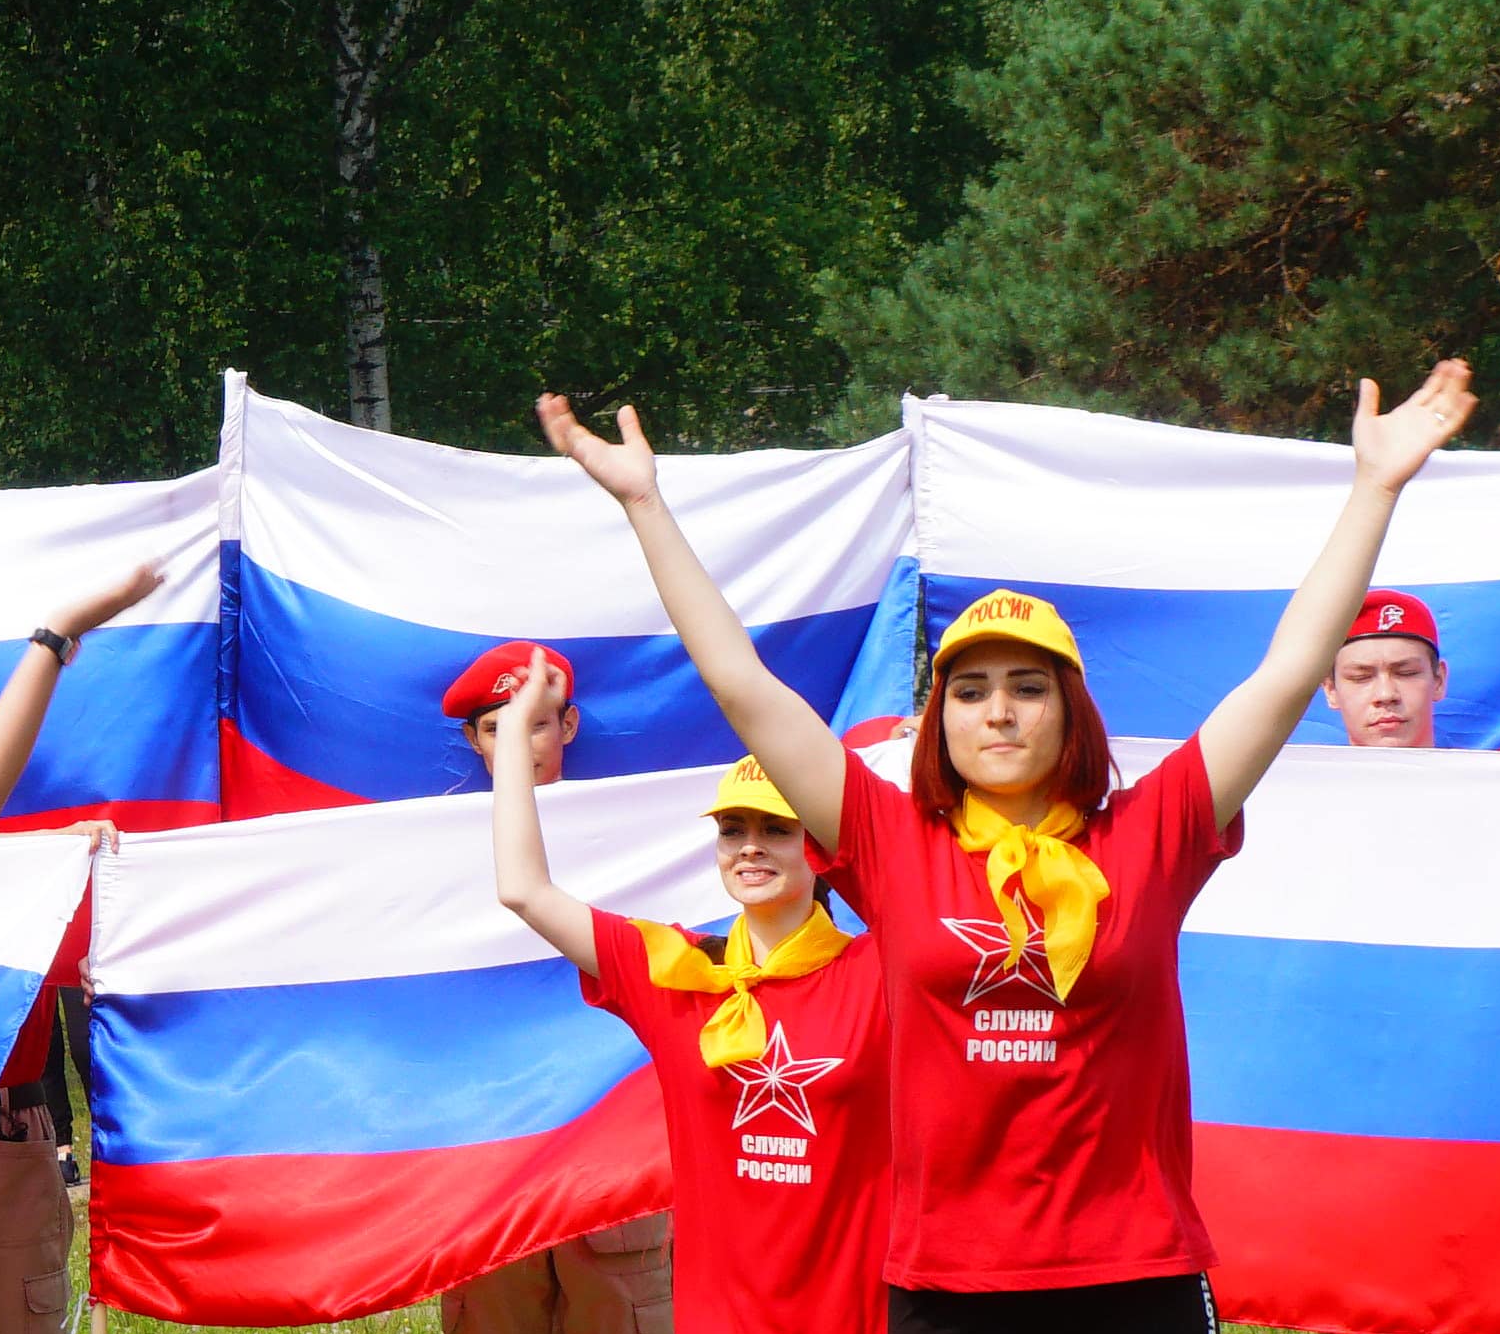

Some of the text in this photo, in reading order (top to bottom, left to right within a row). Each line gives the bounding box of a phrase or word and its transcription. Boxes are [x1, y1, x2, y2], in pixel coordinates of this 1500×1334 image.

[968, 595, 1033, 627] РОССИЯ
[975, 1009, 1054, 1031] СЛУЖУ
[966, 1039, 1057, 1062] РОССИИ
[741, 1134, 808, 1157] СЛУЖУ
[737, 1158, 812, 1184] РОССИИ
